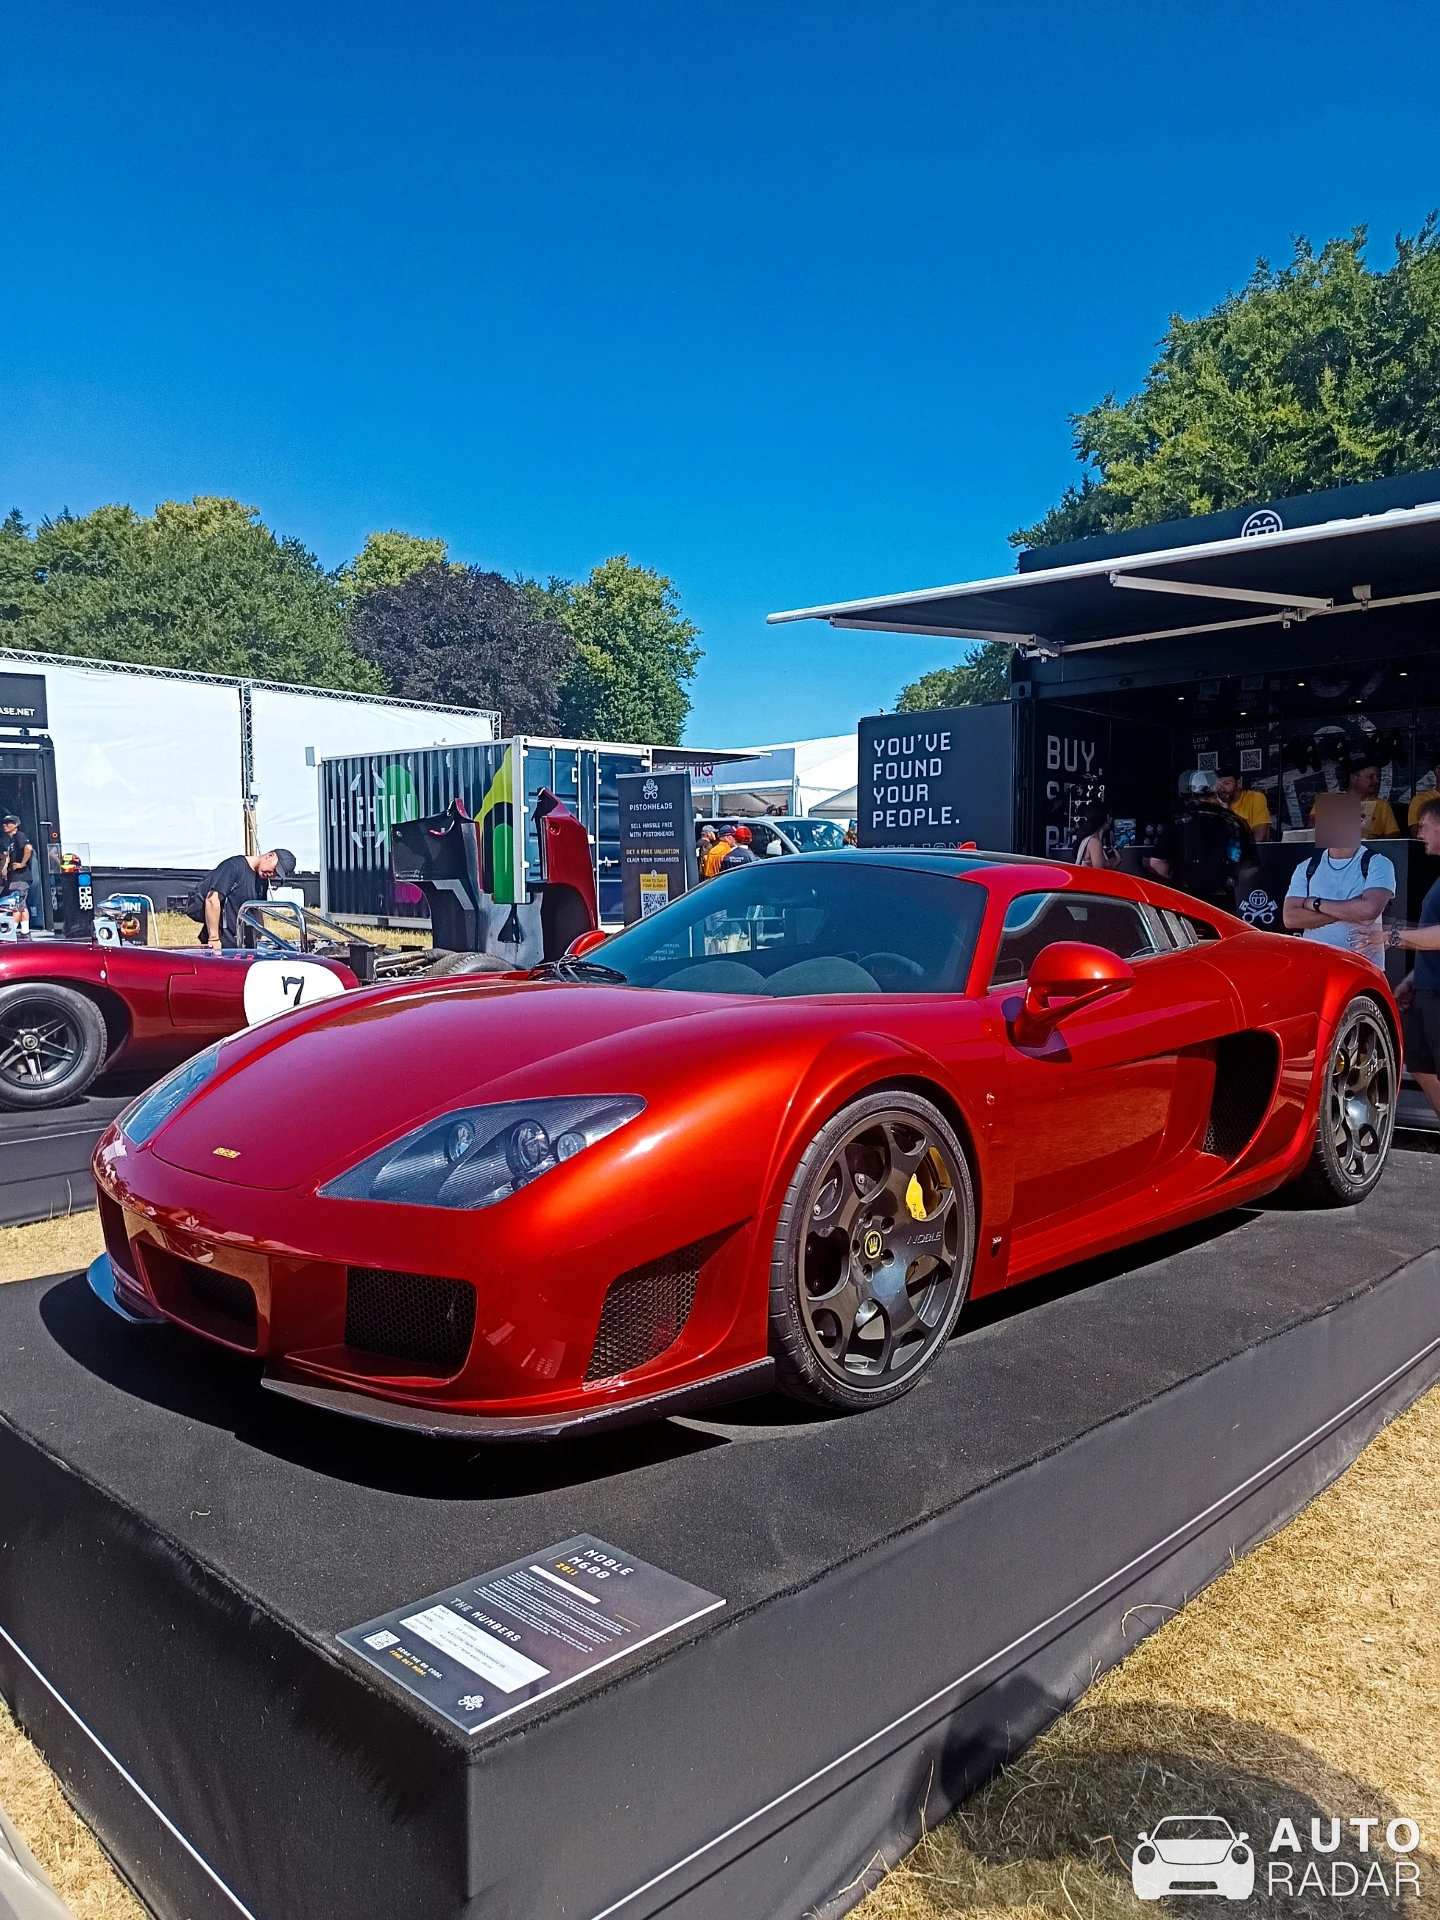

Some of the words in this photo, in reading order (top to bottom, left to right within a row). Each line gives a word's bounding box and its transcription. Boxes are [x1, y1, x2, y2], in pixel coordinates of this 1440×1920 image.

[873, 732, 951, 757] YOU'VE
[873, 758, 942, 781] FOUND
[873, 784, 929, 805] YOUR
[629, 802, 673, 811] PISTONHEADS
[872, 806, 960, 829] PEOPLE.
[281, 976, 305, 1007] 7
[555, 1562, 579, 1576] 2011
[567, 1556, 611, 1579] M600
[583, 1549, 635, 1576] NOBLE
[450, 1597, 474, 1612] THE
[471, 1610, 522, 1642] NUMBERS
